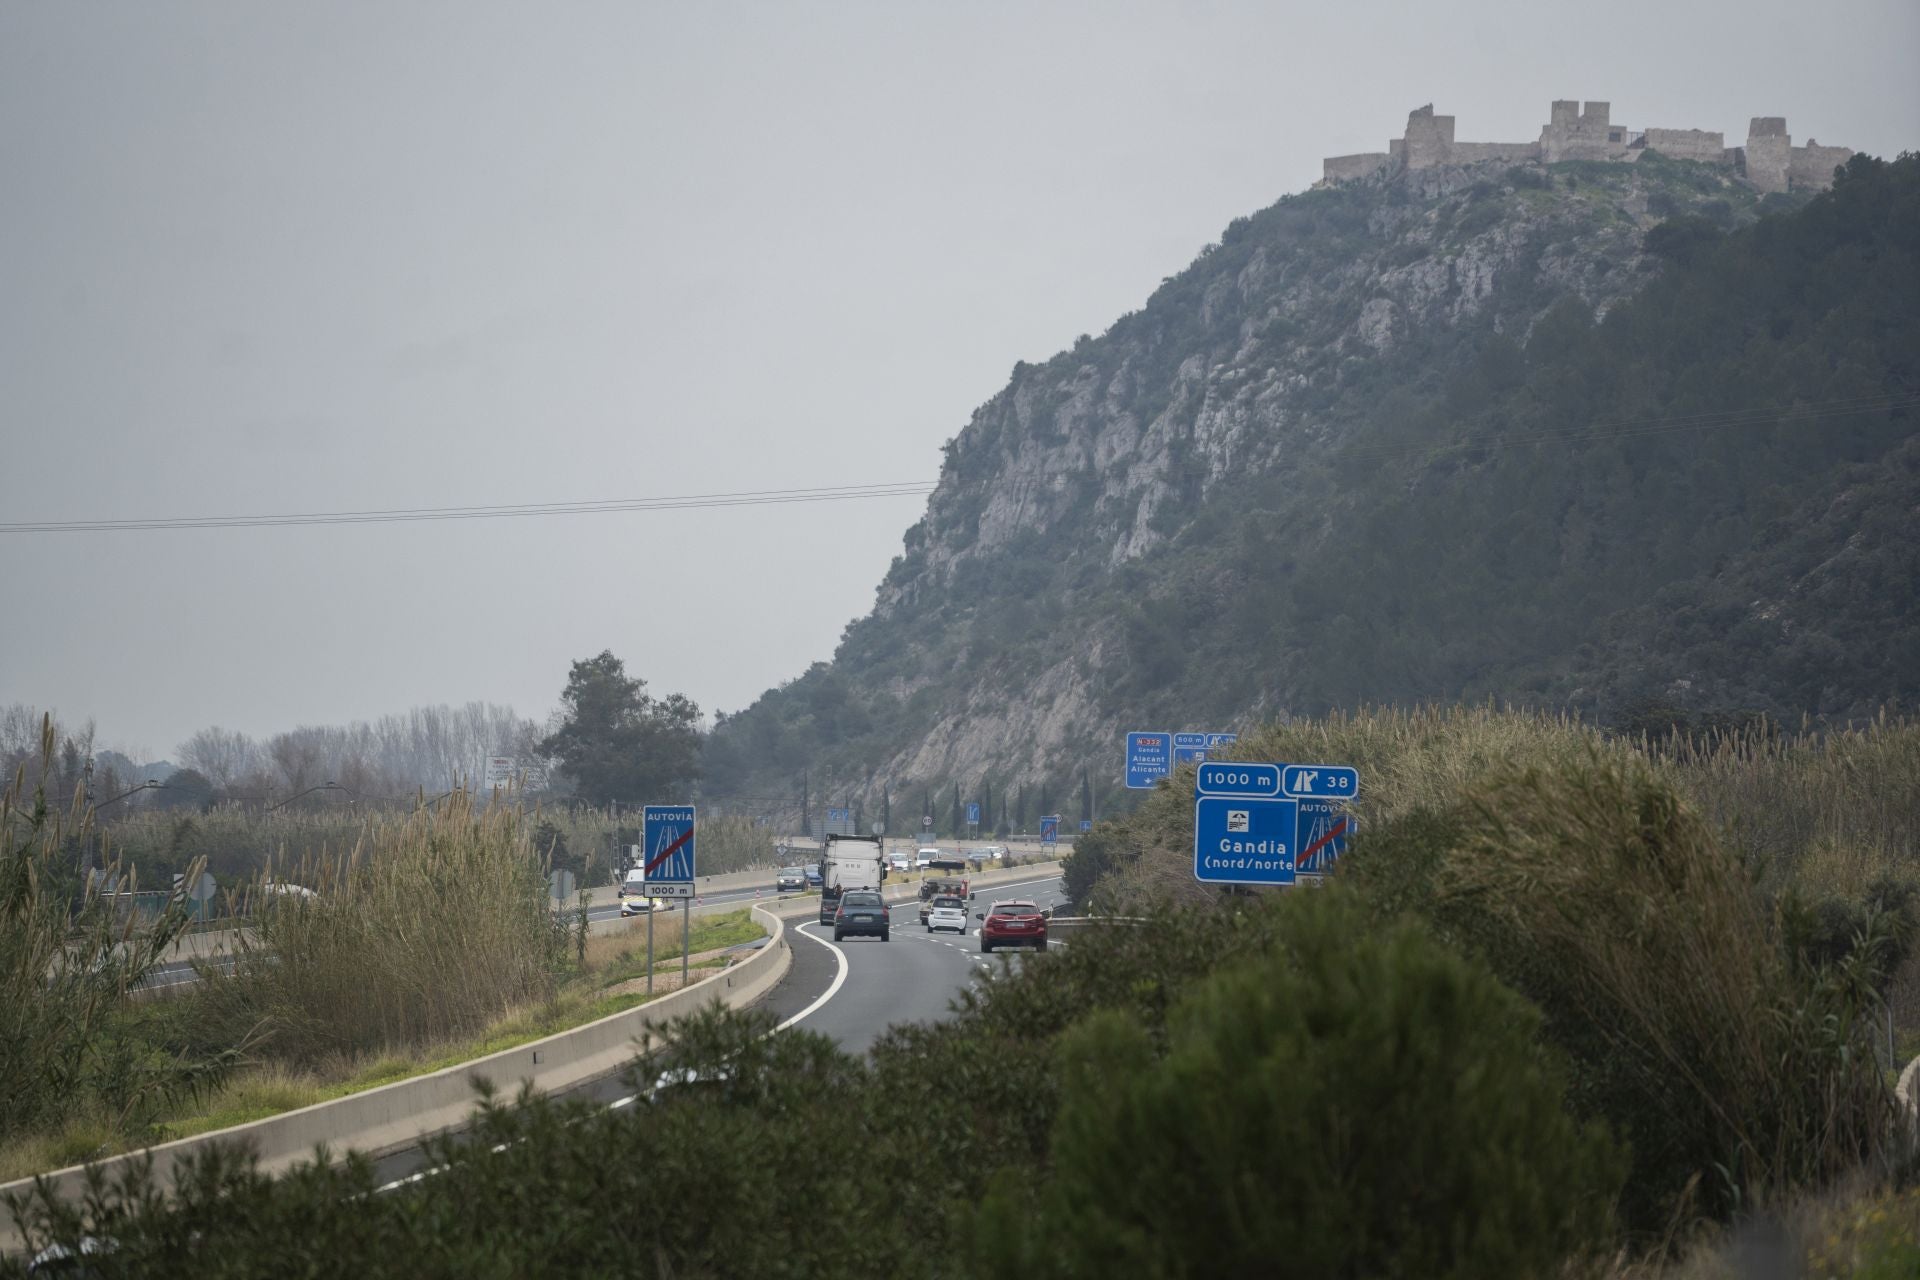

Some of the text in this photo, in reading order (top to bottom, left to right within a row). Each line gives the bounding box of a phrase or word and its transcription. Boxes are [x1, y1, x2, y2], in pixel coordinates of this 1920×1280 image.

[1132, 755, 1165, 763] Alacant
[1130, 765, 1166, 773] Alicante
[1207, 772, 1271, 786] 1000 m
[1327, 776, 1348, 788] 38
[1300, 803, 1337, 813] AUTOV
[648, 811, 692, 820] AUTOVÍA
[1219, 838, 1286, 855] Gandia
[651, 887, 688, 895] 1000 m
